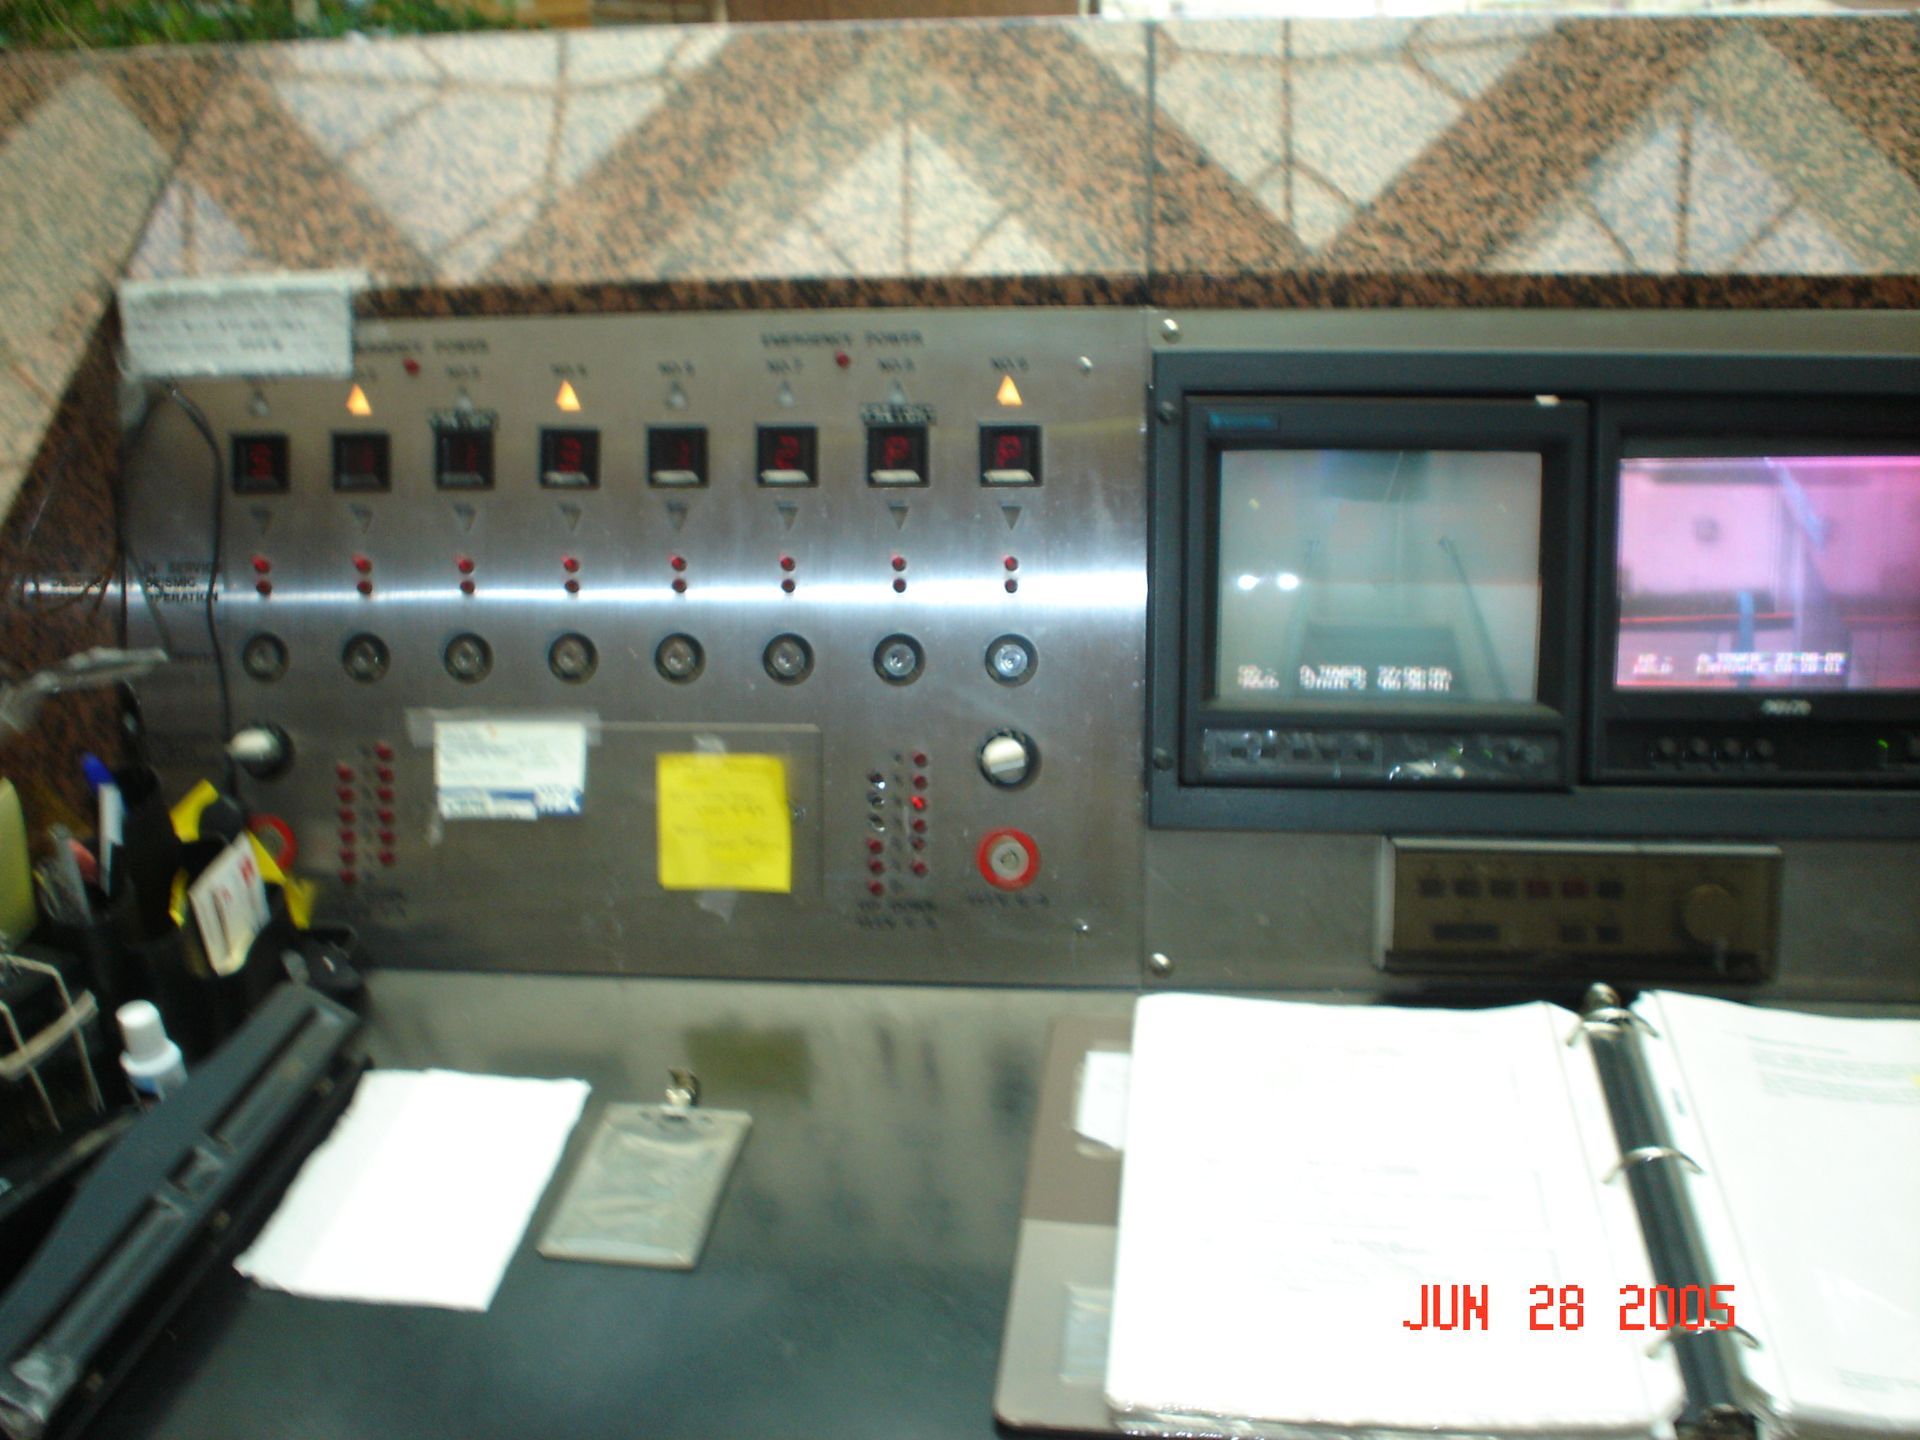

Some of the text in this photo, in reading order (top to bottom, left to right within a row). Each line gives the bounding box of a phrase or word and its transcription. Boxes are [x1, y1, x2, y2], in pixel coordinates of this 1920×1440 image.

[865, 330, 923, 345] POWER
[775, 435, 799, 470] 2
[885, 435, 910, 468] P
[996, 435, 1022, 468] P
